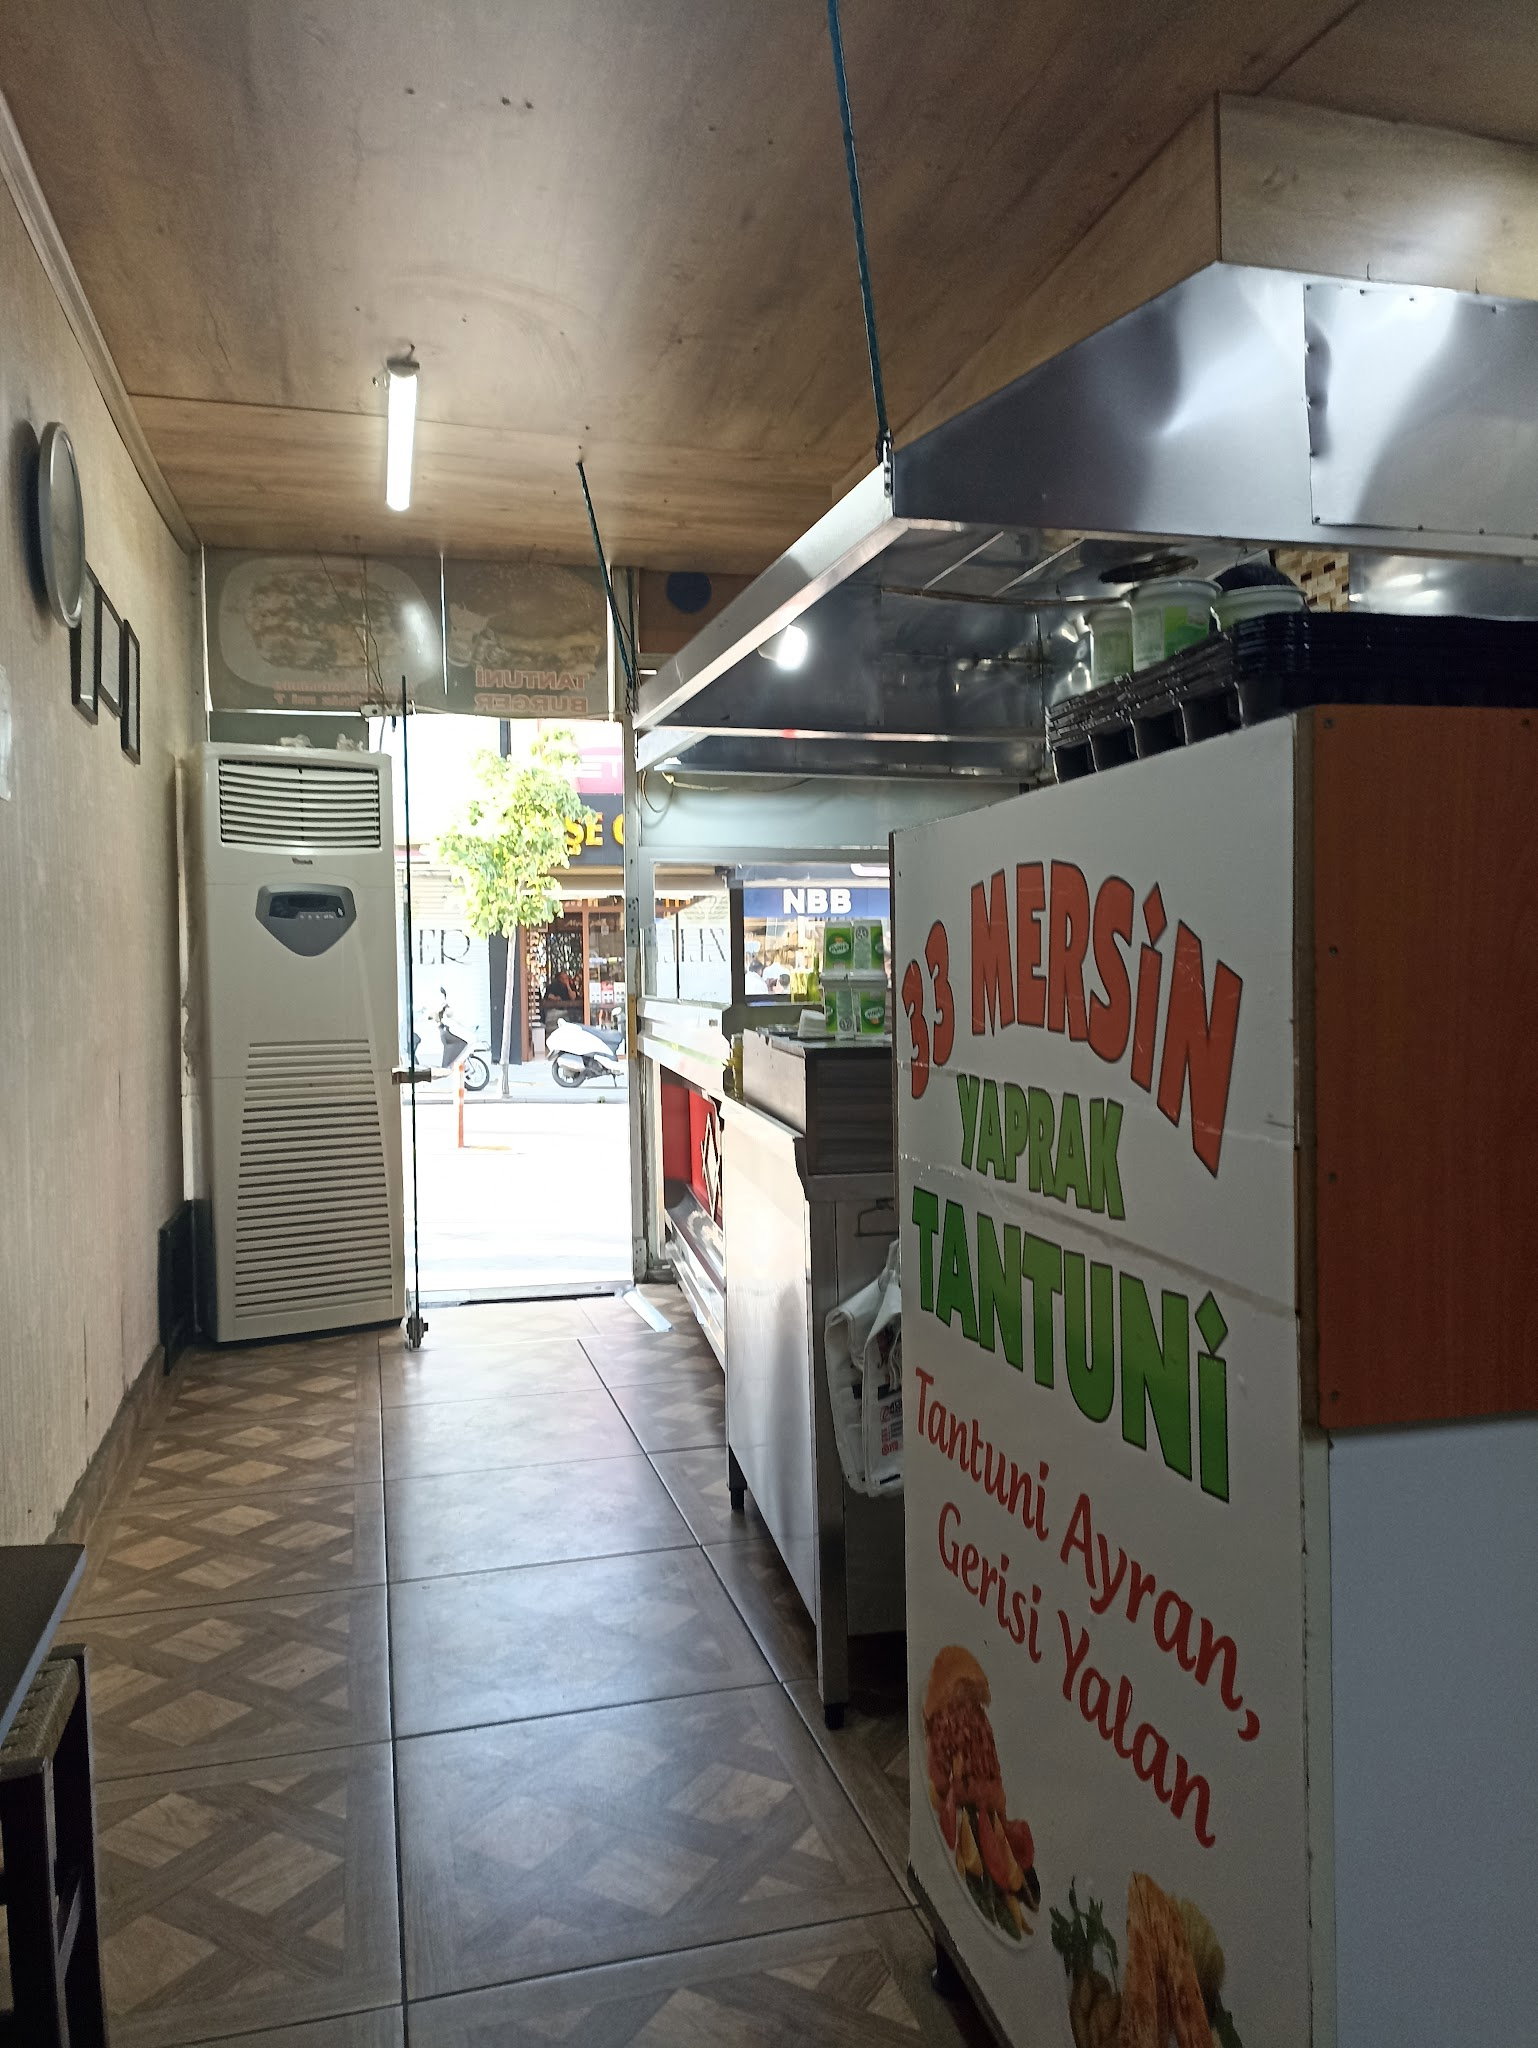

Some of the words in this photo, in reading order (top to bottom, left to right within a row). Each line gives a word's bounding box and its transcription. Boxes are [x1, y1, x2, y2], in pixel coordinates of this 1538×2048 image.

[782, 888, 851, 914] NBB
[901, 919, 955, 1100] 33
[957, 1073, 1126, 1220] YAPRAK
[915, 1366, 1050, 1541] Tantuni
[1059, 1493, 1260, 1742] Ayran,
[938, 1502, 1042, 1663] Gerisi
[1057, 1609, 1216, 1849] Yalan
